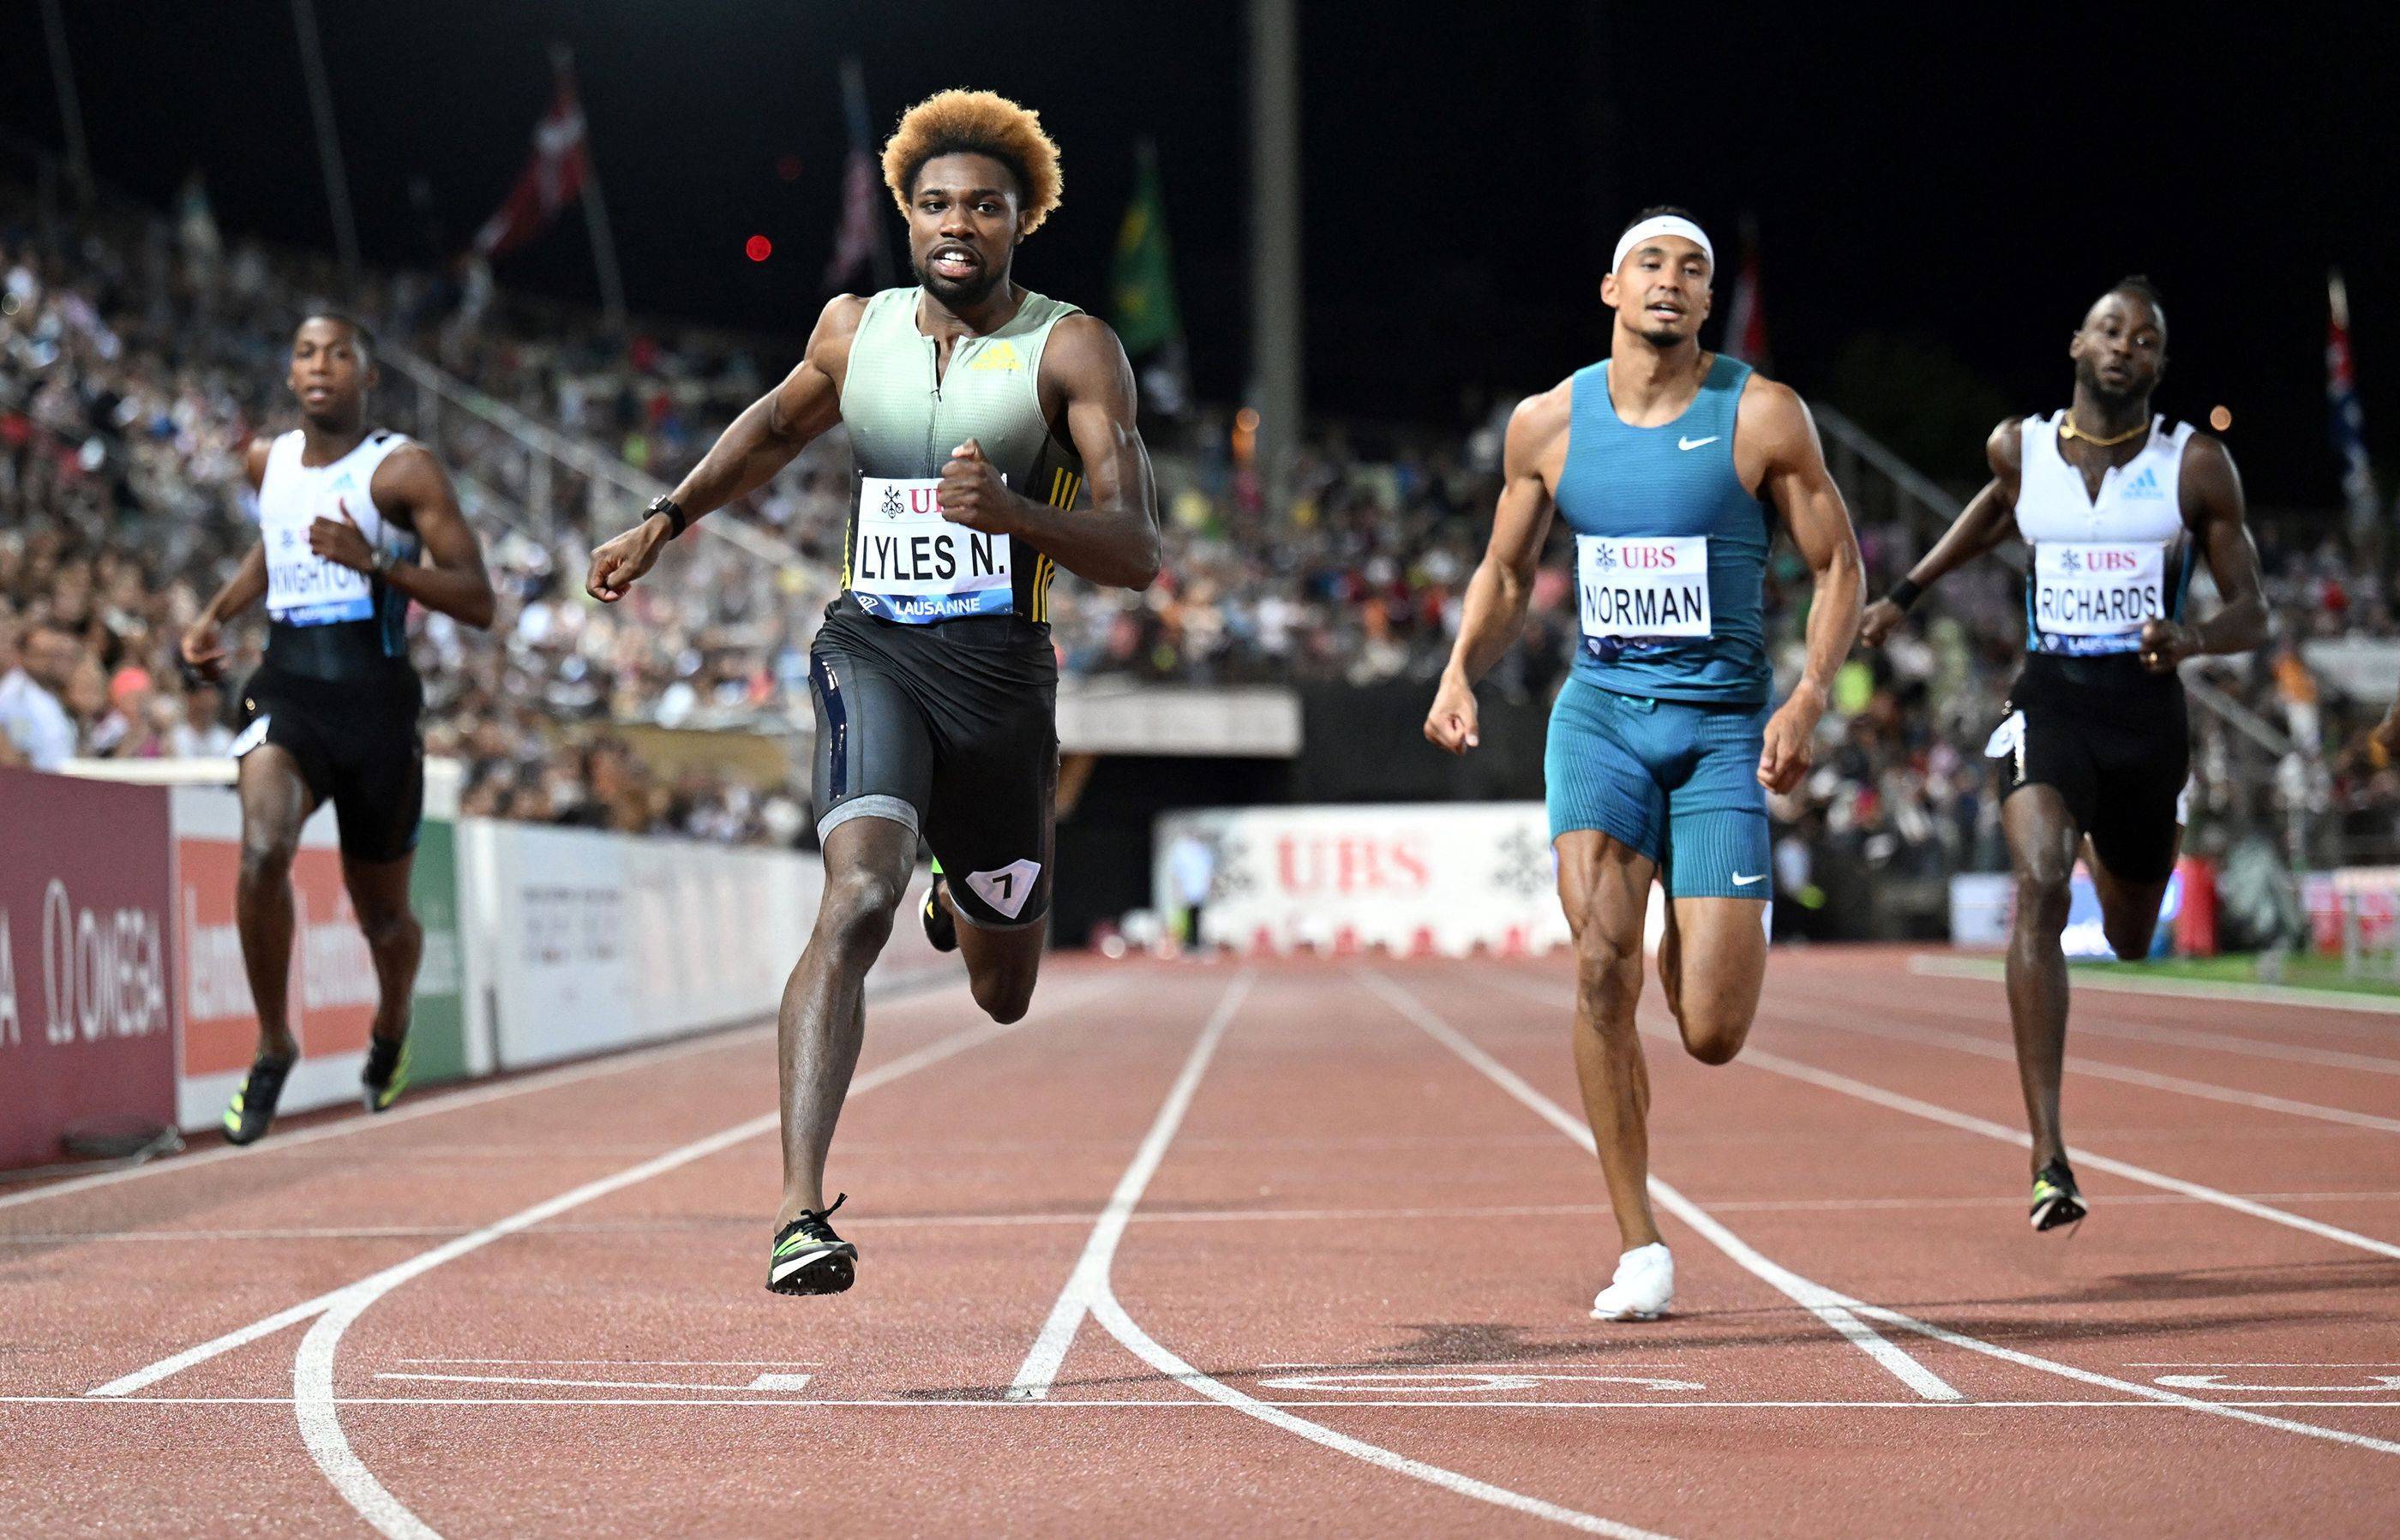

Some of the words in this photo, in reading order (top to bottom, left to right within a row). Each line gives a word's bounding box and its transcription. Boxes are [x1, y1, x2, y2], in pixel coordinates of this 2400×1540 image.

[861, 535, 957, 580] LYLES
[970, 533, 1005, 577] N.
[1621, 546, 1677, 568] UBS
[2086, 550, 2138, 572] UBS
[894, 598, 981, 615] LAUSANNE
[1586, 585, 1702, 626] NORMAN
[2042, 586, 2157, 623] RICHARDS
[1275, 830, 1430, 894] UBS
[992, 872, 1013, 899] 7
